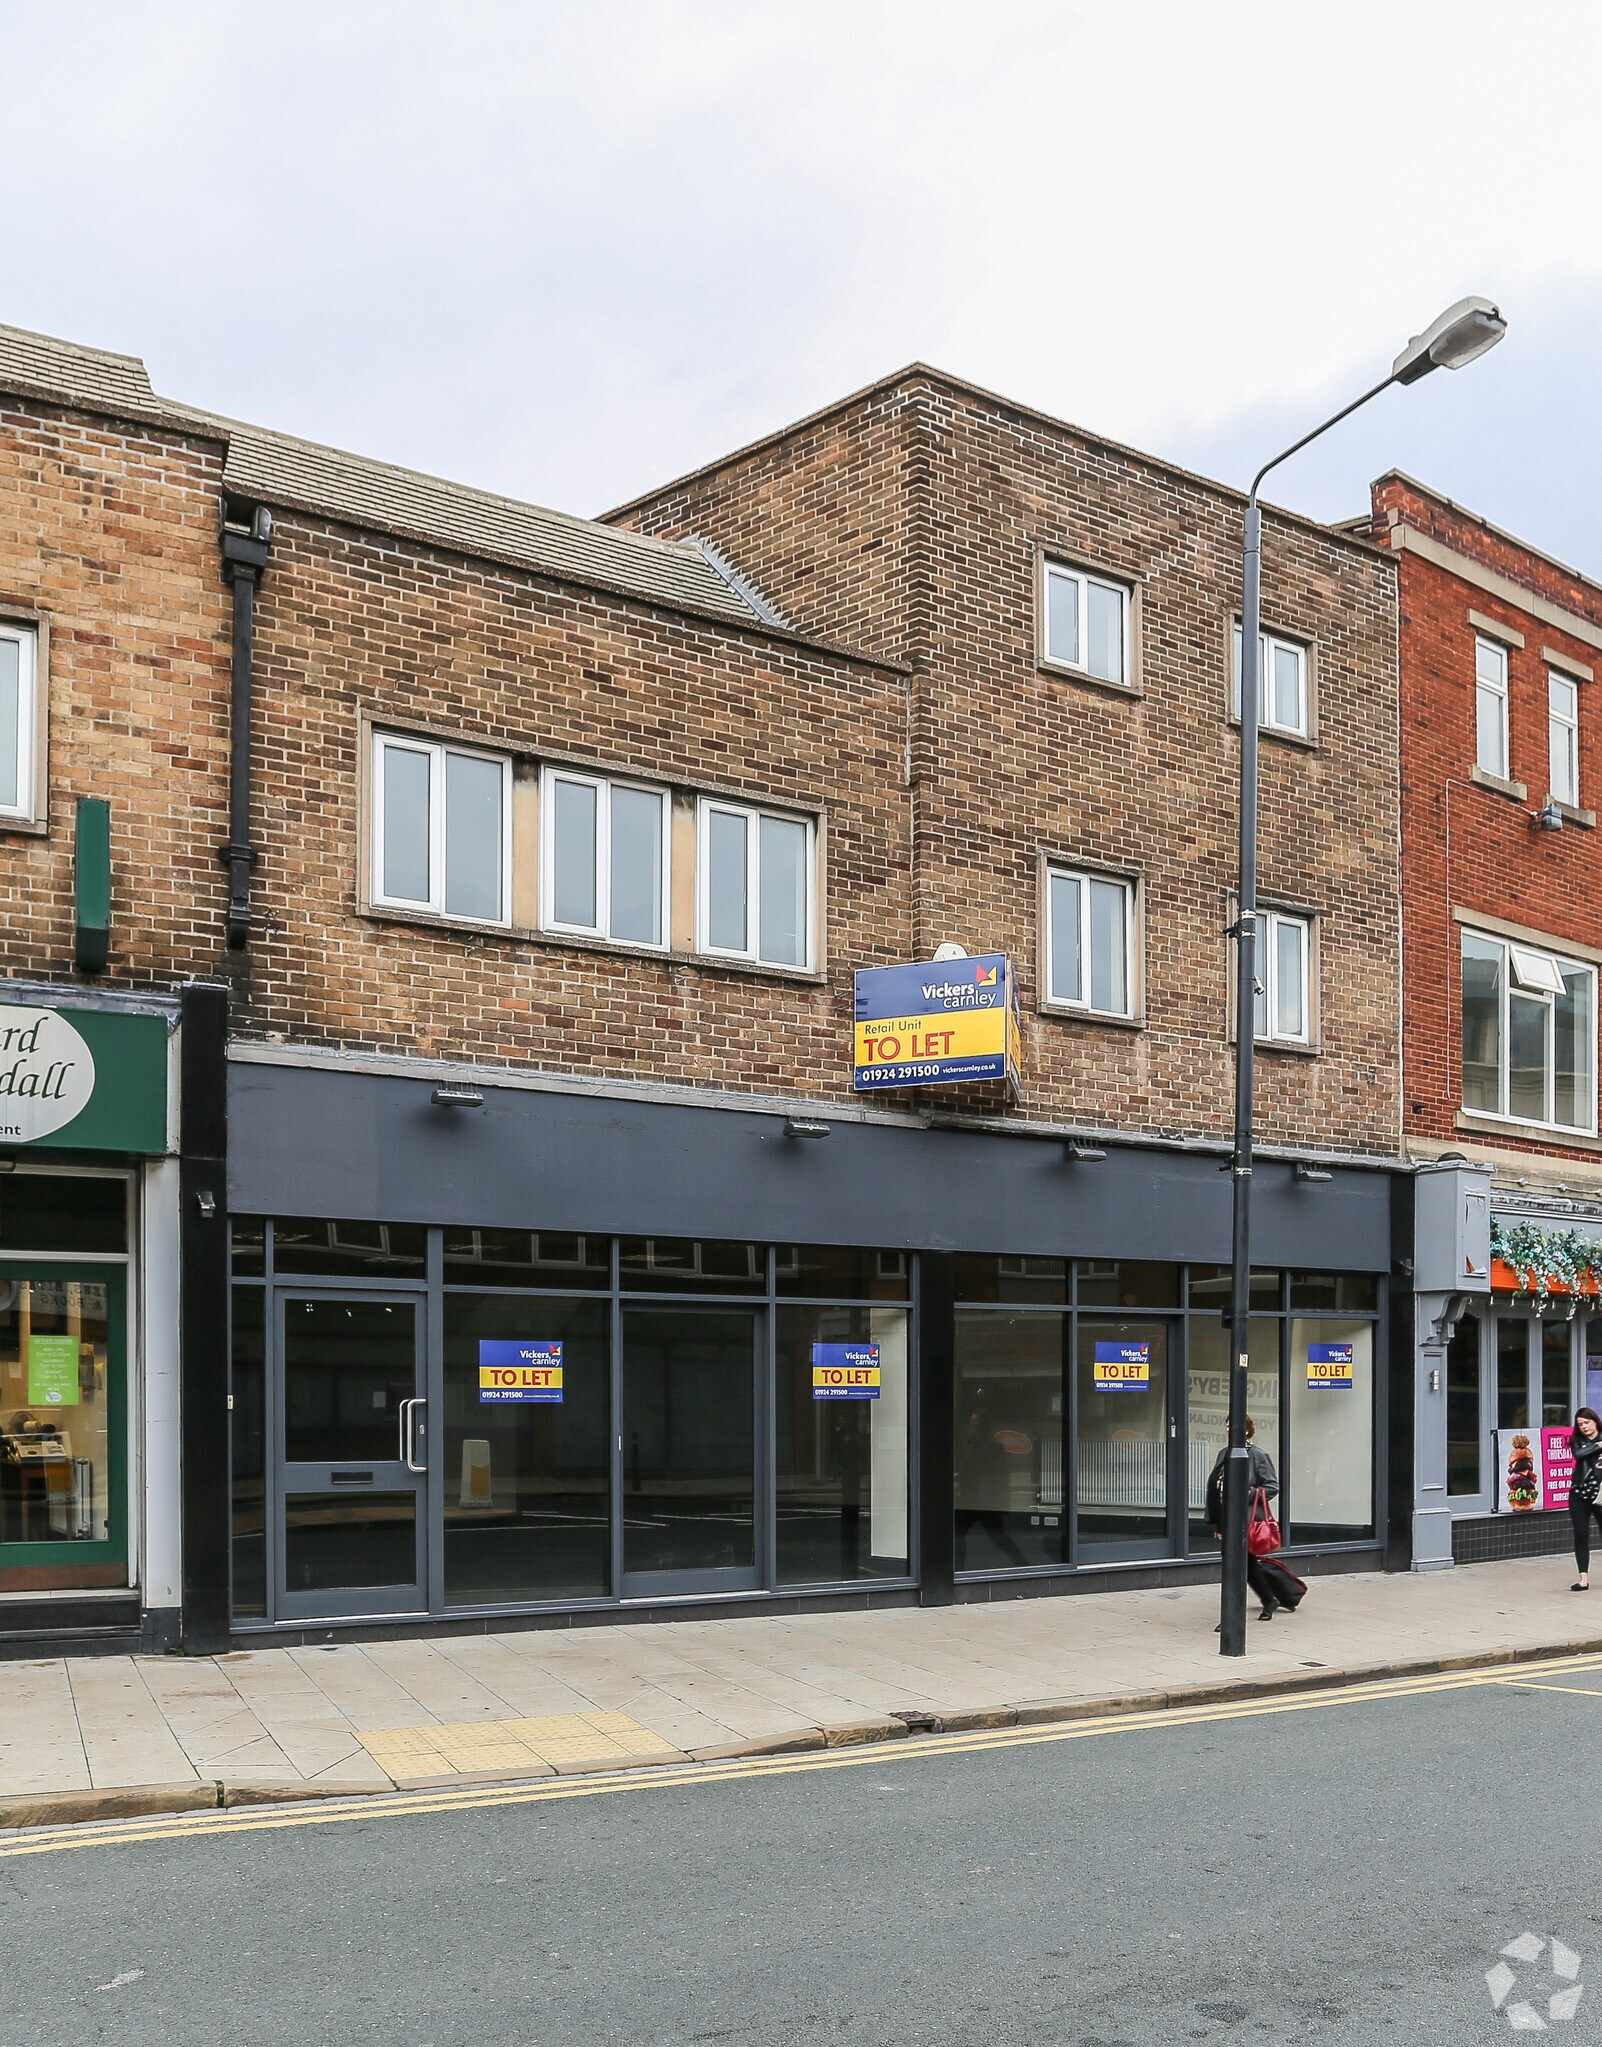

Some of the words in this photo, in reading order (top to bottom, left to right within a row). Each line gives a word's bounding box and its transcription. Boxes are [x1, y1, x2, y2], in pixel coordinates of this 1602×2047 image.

[922, 981, 975, 1000] Vickers
[943, 990, 997, 1009] carnley
[865, 1022, 895, 1035] Retail
[898, 1020, 922, 1032] Unit
[0, 1016, 49, 1053] rd
[864, 1036, 901, 1062] TO
[912, 1031, 955, 1058] LET
[862, 1068, 896, 1082] 01924
[899, 1064, 940, 1078] 291500
[942, 1063, 997, 1074] vickerscarnley.co.uk
[520, 1350, 550, 1359] Vickers
[845, 1352, 871, 1360] Vickers
[1120, 1349, 1141, 1357] Vickers
[532, 1357, 561, 1367] carnley
[855, 1358, 878, 1367] carnley
[821, 1370, 843, 1384] TO
[847, 1370, 871, 1384] LET
[1101, 1365, 1119, 1378] TO
[1122, 1366, 1142, 1378] LET
[1313, 1365, 1327, 1376] TO
[1330, 1365, 1347, 1377] LET
[490, 1370, 517, 1386] TO
[522, 1370, 552, 1386] LET
[482, 1391, 500, 1399] 01924
[501, 1391, 523, 1399] 291500
[1550, 1437, 1562, 1449] FREE
[1547, 1448, 1573, 1460] THURSDA
[1550, 1468, 1557, 1477] GO
[1547, 1480, 1558, 1490] FREE
